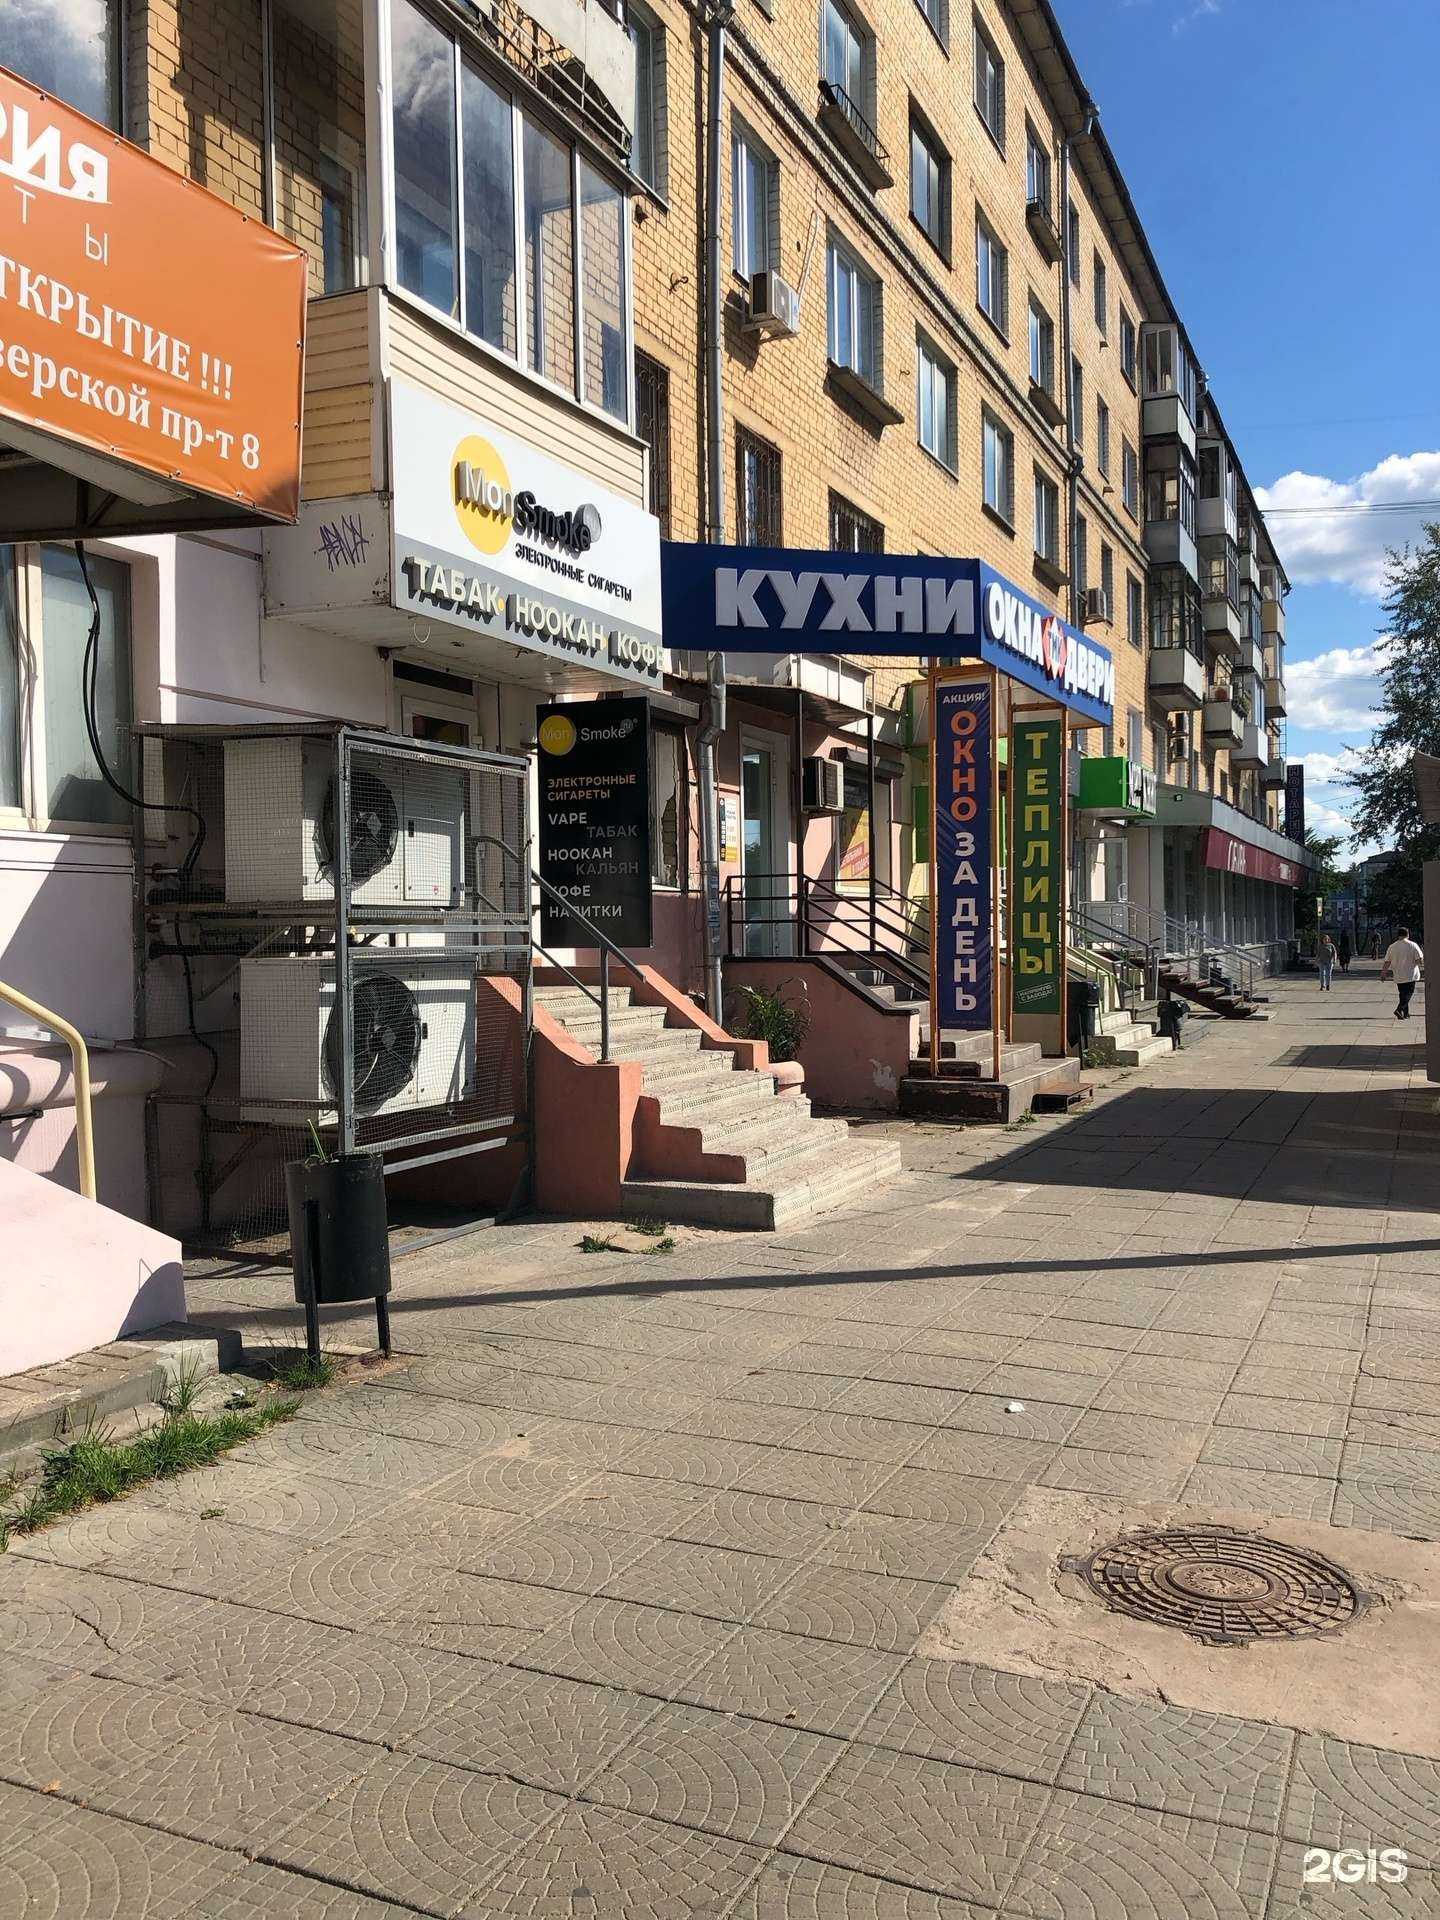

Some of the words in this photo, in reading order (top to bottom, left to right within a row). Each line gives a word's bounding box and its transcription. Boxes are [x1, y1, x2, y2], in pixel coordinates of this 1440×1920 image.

[0, 102, 110, 203] ИЯ
[160, 405, 234, 460] пр-т
[240, 432, 260, 470] 8
[456, 459, 514, 523] Mon
[513, 490, 592, 552] Smoke
[413, 557, 500, 617] ТАБАК
[515, 542, 585, 584] ЭЛЕКТРОННЫЕ
[587, 572, 633, 602] СИГАРЕТЫ
[715, 567, 975, 635] КУХНИ
[988, 582, 1045, 667] ОКНА
[1064, 635, 1115, 706] ДВЕРИ
[943, 691, 986, 704] АКЦИЯ!
[580, 725, 627, 741] Smoke
[547, 774, 637, 789] ЭЛЕКТРОННЫЕ
[547, 789, 611, 802] СИГАРЕТЫ
[950, 711, 977, 823] ОКНО
[548, 812, 588, 826] VAPE
[586, 824, 639, 839] ТАБАК
[575, 861, 639, 877] КАЛЬЯН
[952, 831, 979, 885] ЗА
[1020, 732, 1053, 975] ТЕПЛИЦЫ
[552, 884, 591, 898] ОФЕ
[952, 897, 979, 1012] ДЕНЬ
